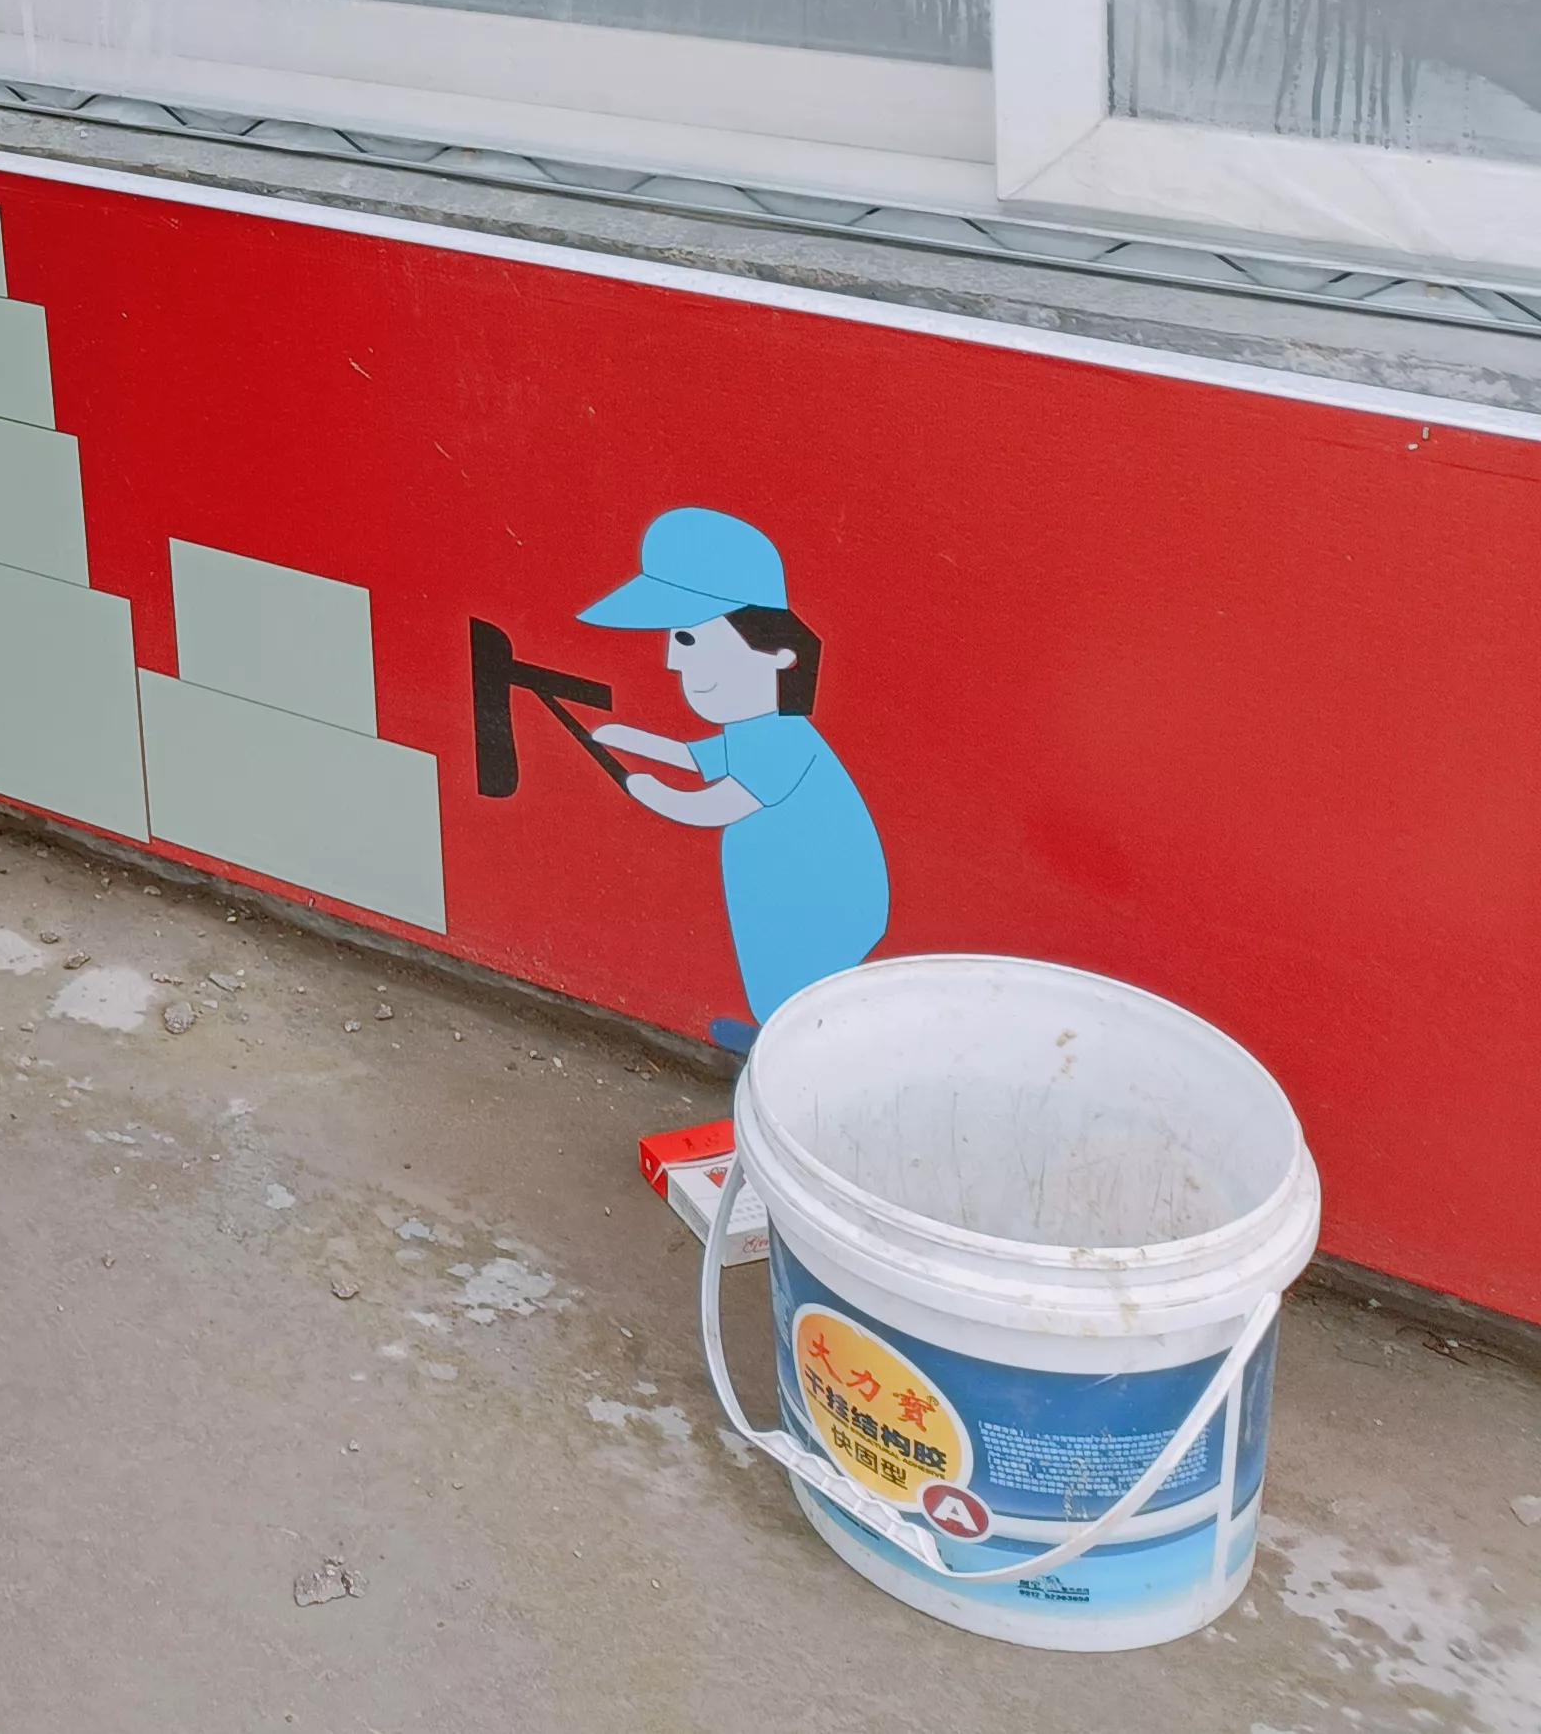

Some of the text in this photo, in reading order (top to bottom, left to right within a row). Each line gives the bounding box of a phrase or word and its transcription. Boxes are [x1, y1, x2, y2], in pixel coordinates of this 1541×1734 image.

[830, 1423, 909, 1490] 快固型
[931, 1494, 981, 1533] A
